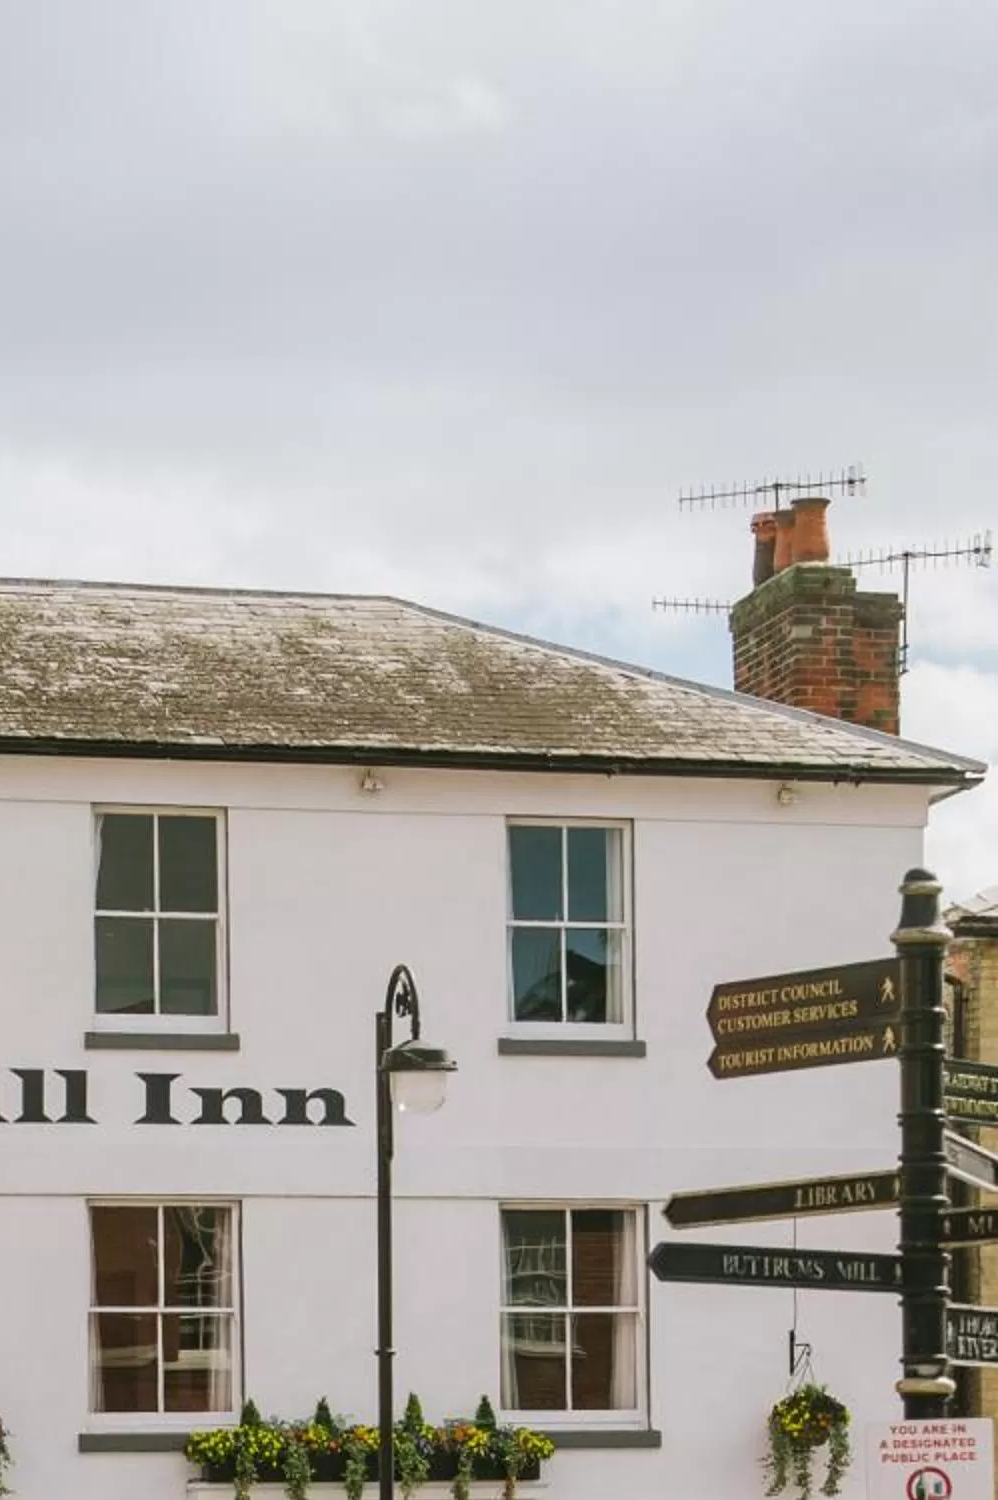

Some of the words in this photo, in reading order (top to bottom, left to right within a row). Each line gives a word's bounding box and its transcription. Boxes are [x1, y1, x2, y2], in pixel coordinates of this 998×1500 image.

[718, 989, 779, 1010] DISTRICT
[781, 979, 843, 1000] COUNCIL
[717, 1012, 791, 1034] CUSTOMER
[793, 1000, 859, 1023] SERVICES
[718, 1051, 775, 1071] TOURIST
[777, 1035, 875, 1061] INFORMATION
[134, 1072, 357, 1126] Inn
[794, 1182, 876, 1208] LIBRARY
[836, 1261, 881, 1281] MILL
[890, 1425, 917, 1435] YOU
[922, 1425, 948, 1435] ARE
[953, 1424, 966, 1434] IN
[879, 1440, 889, 1449] A
[892, 1438, 977, 1449] DESIGNATED
[882, 1453, 929, 1463] PUBLIC
[934, 1451, 977, 1462] PLACE
